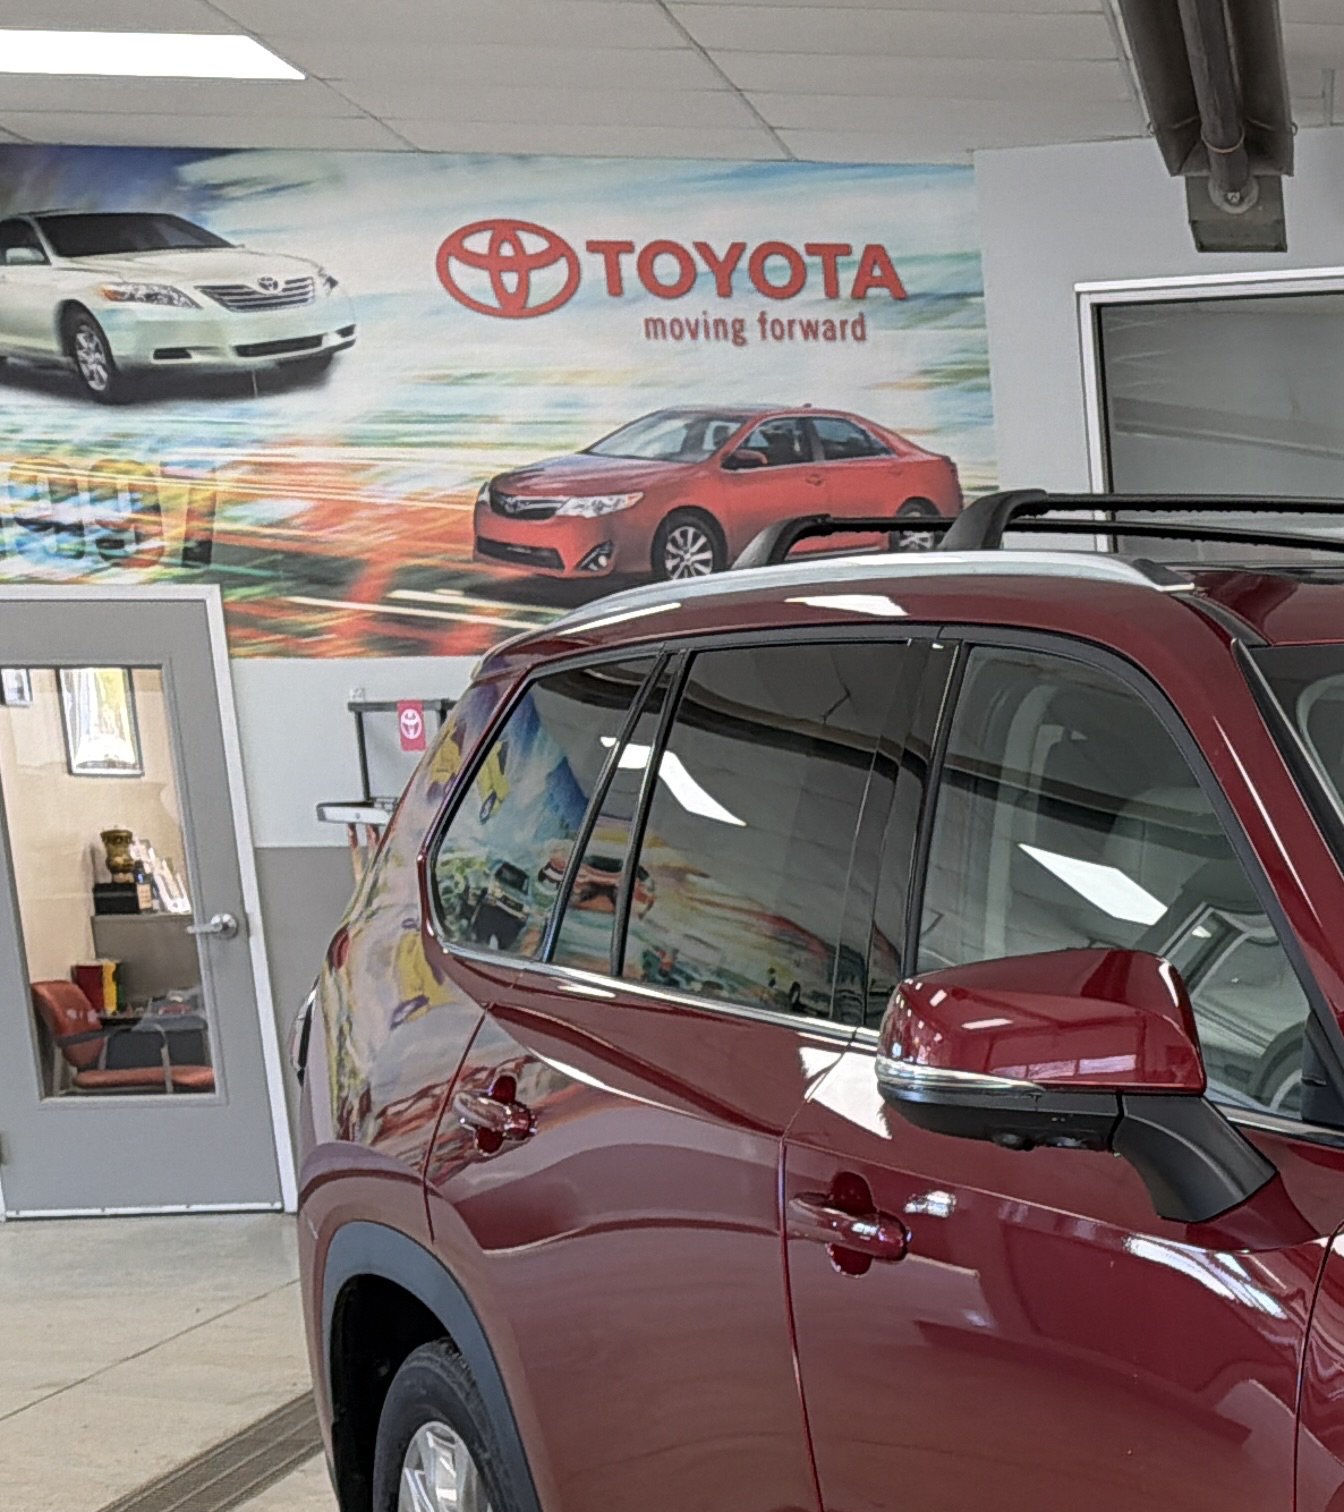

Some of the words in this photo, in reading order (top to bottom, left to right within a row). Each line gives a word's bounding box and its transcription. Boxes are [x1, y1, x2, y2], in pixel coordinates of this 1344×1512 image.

[586, 239, 908, 300] TOYOTA
[644, 311, 747, 347] moving
[757, 311, 868, 342] forward
